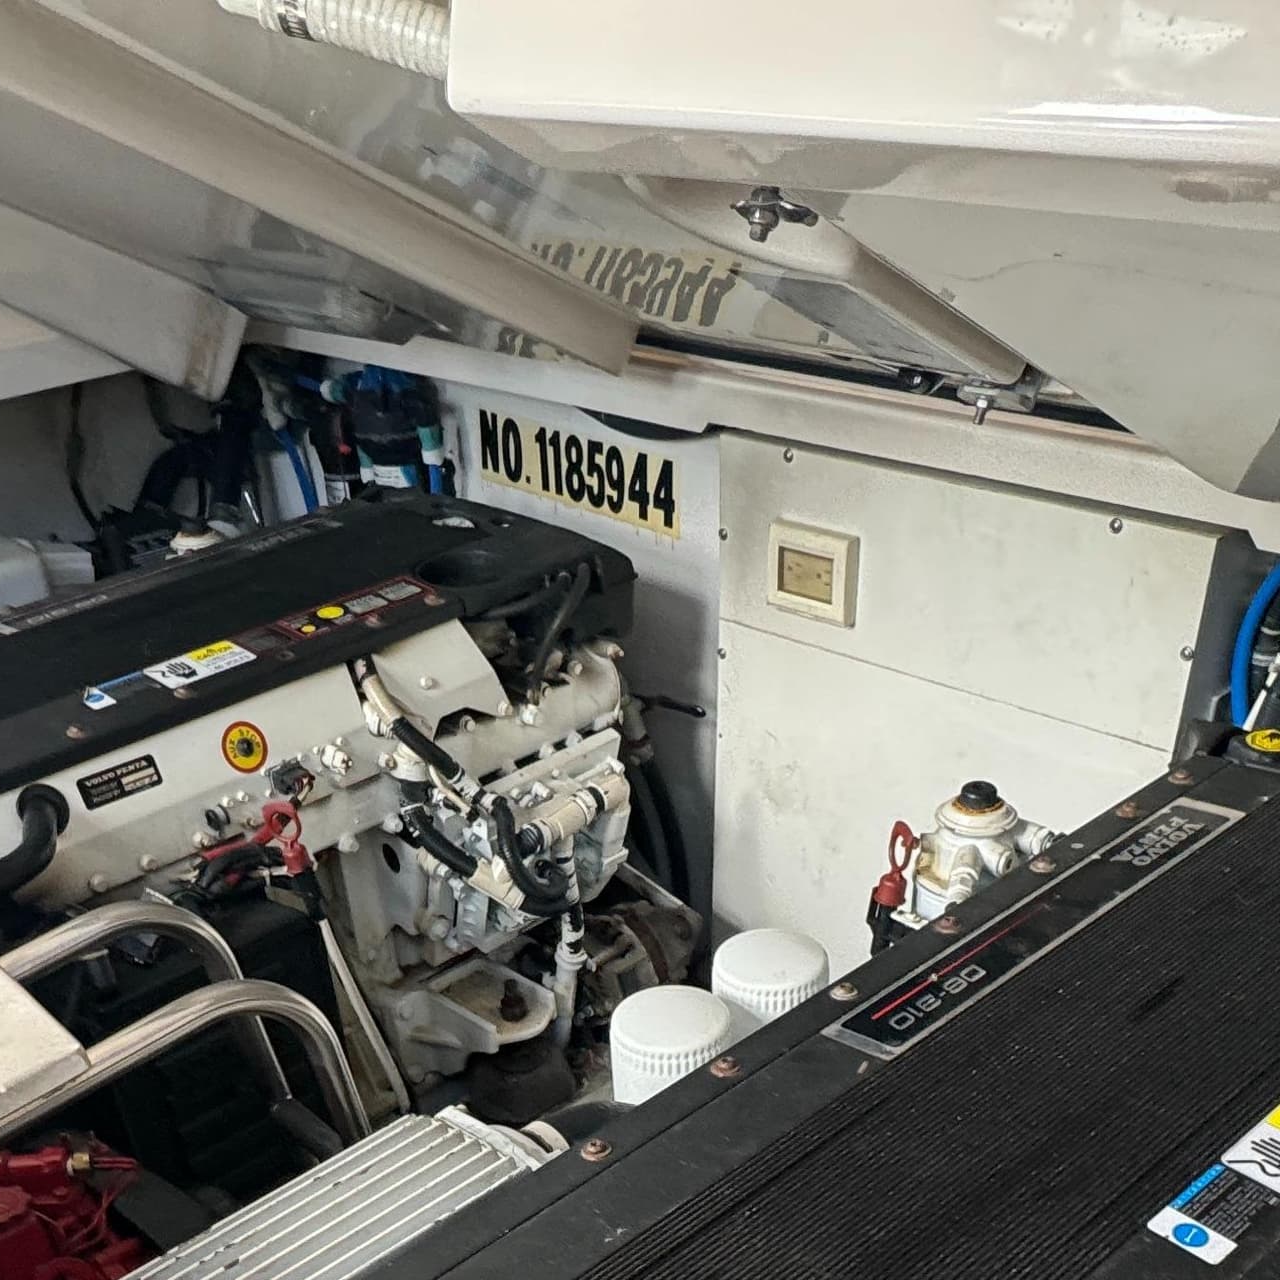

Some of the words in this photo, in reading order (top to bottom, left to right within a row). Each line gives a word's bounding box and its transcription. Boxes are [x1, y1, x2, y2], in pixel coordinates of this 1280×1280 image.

[85, 771, 116, 788] VOLVO
[116, 759, 149, 776] PENTA
[1109, 816, 1190, 862] PENTA
[1132, 823, 1206, 867] VOLVO
[888, 964, 987, 1032] D6-310
